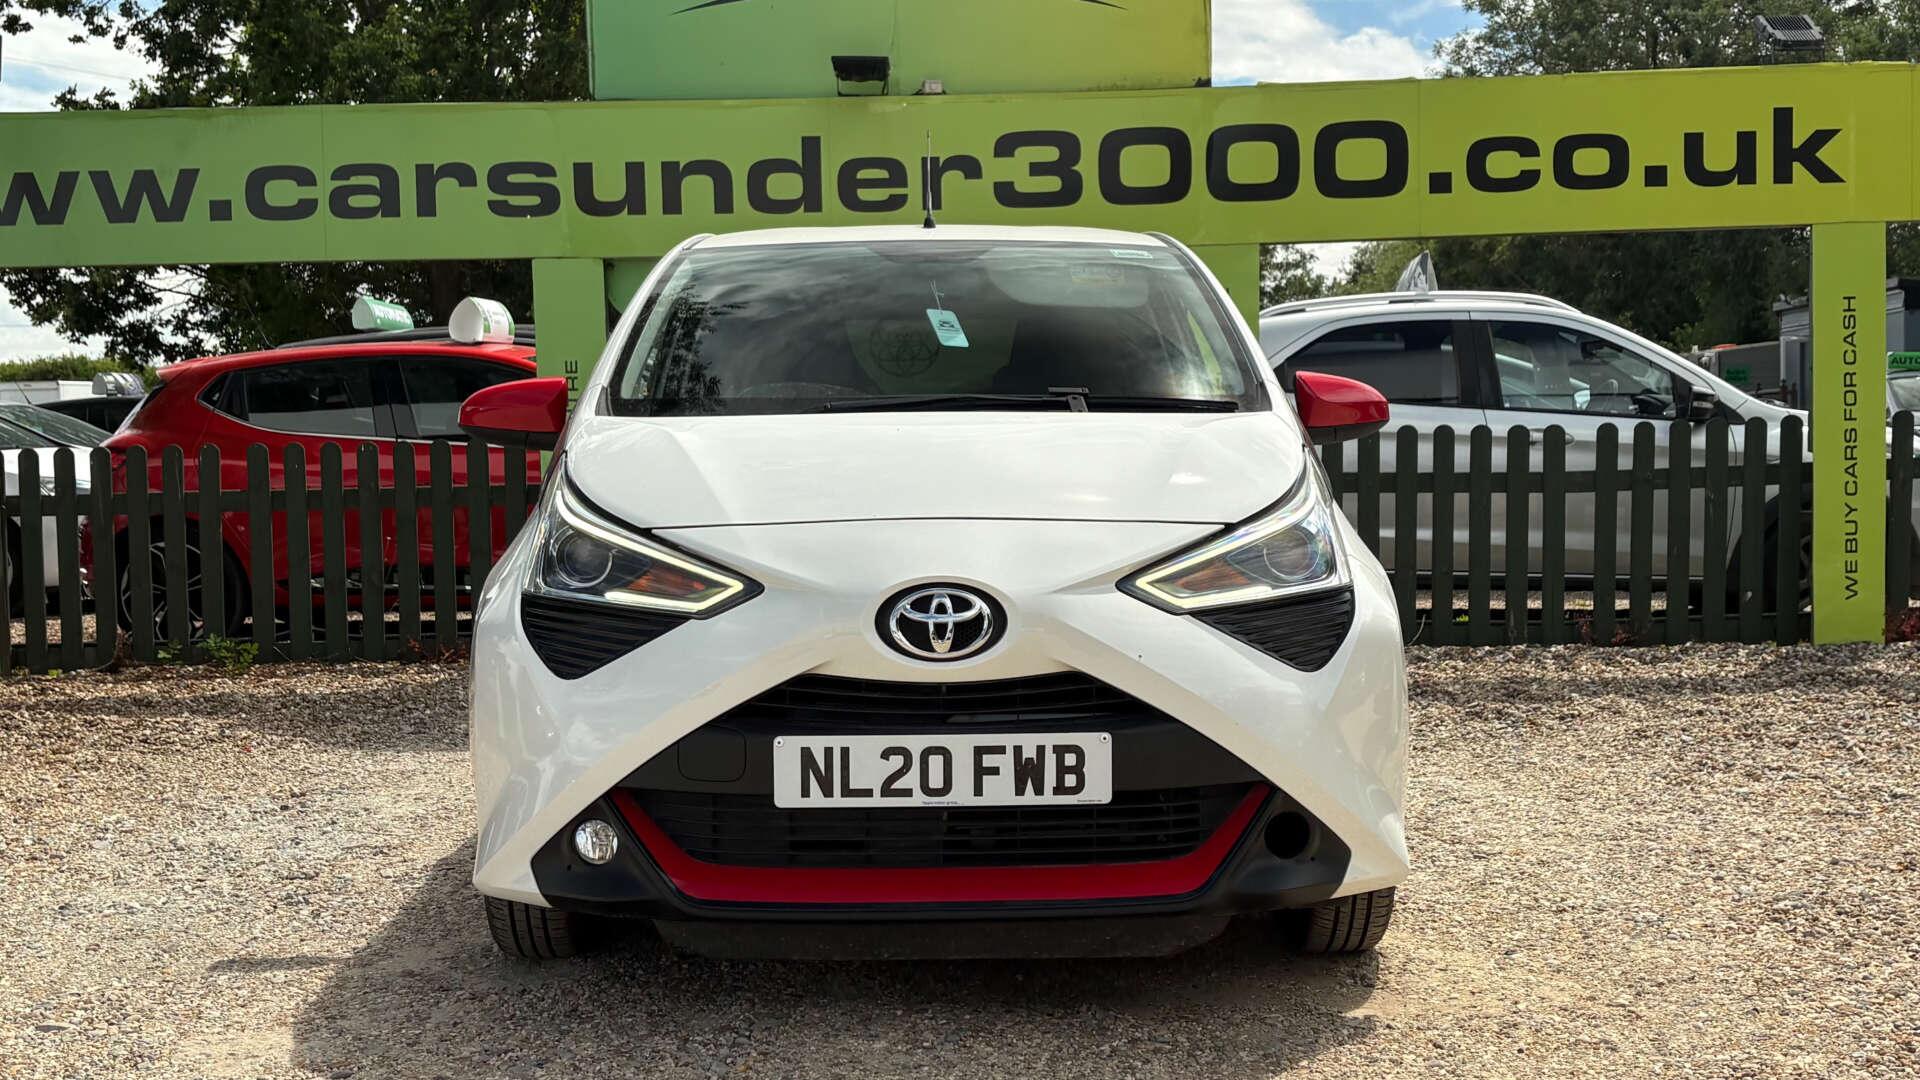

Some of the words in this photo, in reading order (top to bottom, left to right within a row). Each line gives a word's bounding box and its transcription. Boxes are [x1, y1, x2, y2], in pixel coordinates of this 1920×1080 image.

[1842, 295, 1857, 366] CASH
[1843, 371, 1858, 421] FOR
[1843, 427, 1858, 497] CARS
[1844, 502, 1859, 554] BUY
[1844, 559, 1859, 600] WE
[800, 745, 953, 798] NL20
[973, 744, 1086, 797] FWB
